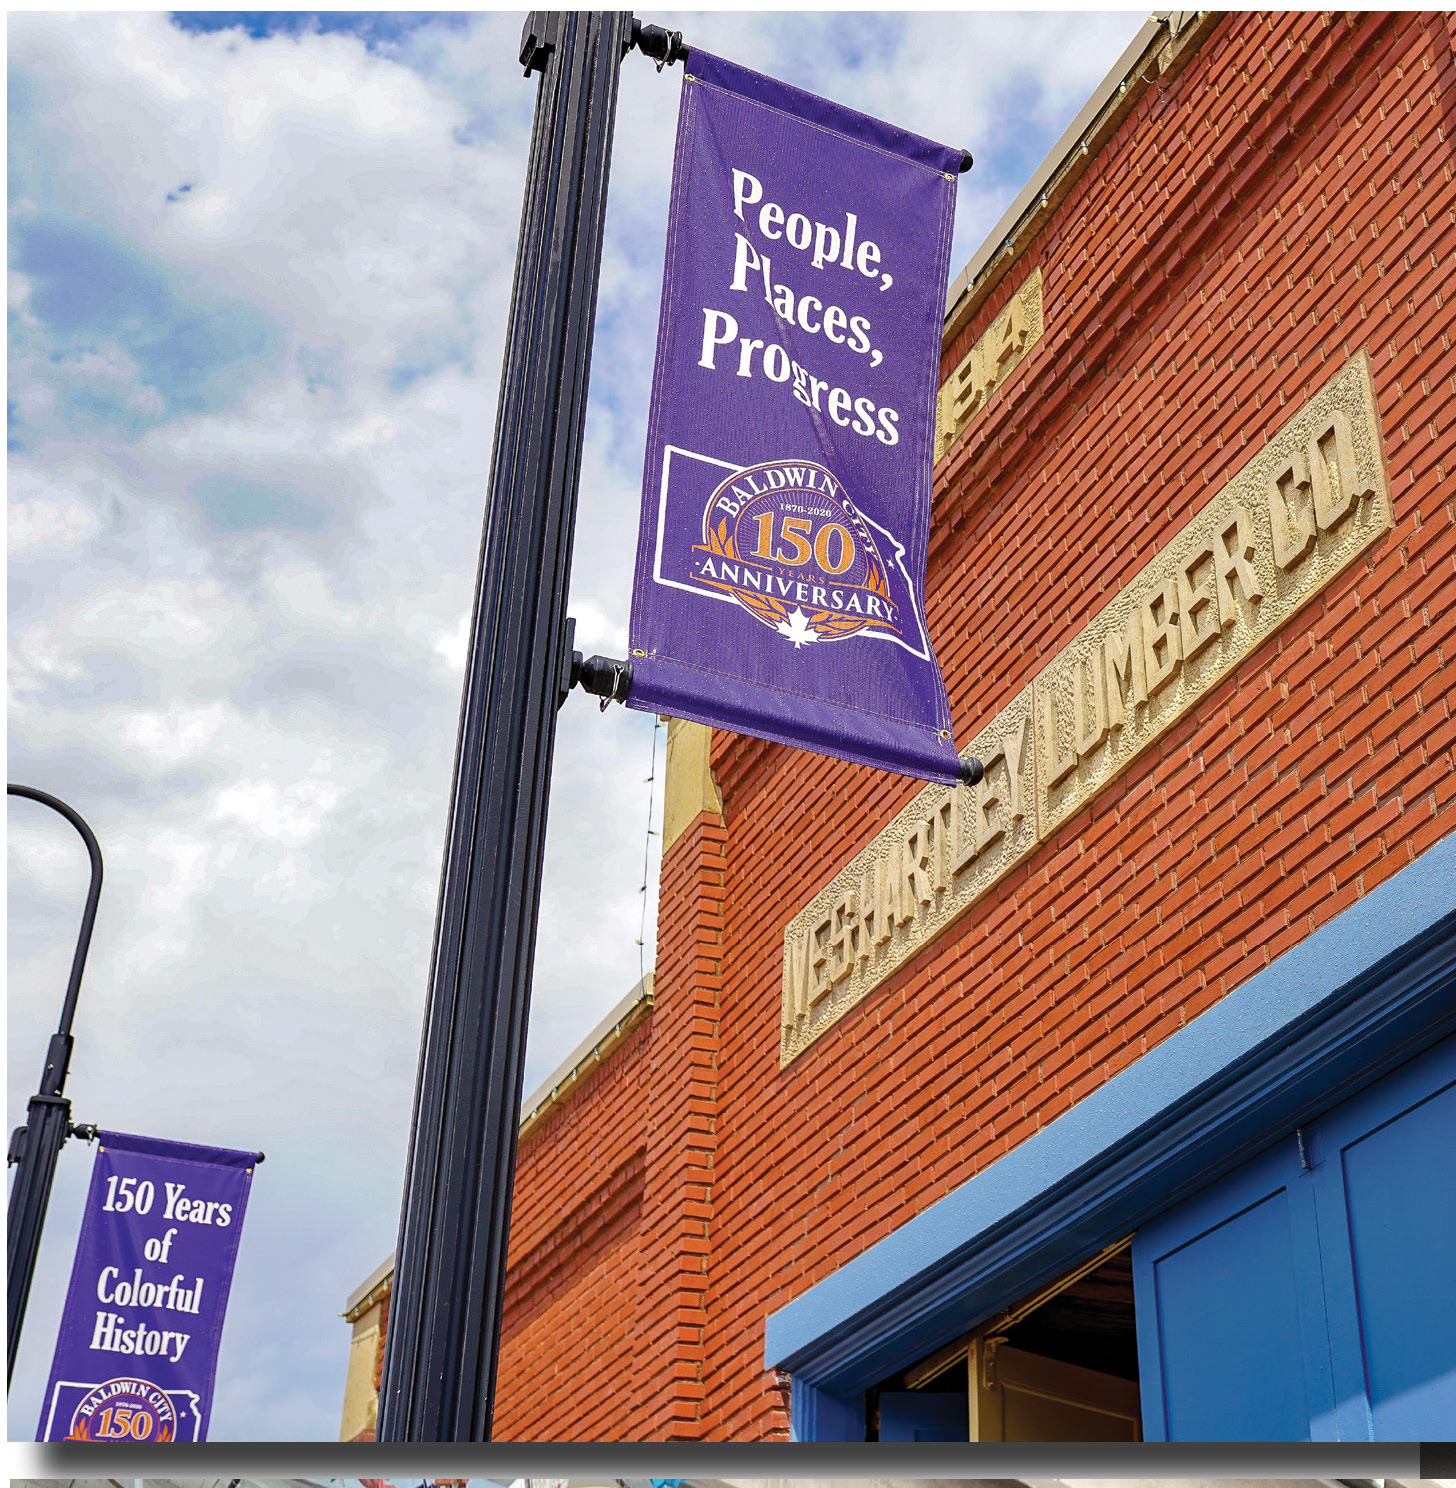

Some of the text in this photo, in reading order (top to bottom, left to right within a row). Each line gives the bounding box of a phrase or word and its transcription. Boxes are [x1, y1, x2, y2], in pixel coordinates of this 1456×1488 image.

[732, 168, 893, 292] People,
[730, 232, 883, 368] Places,
[698, 308, 899, 445] Progress
[942, 293, 1029, 438] 1914
[716, 467, 877, 560] BALDWIN CITY
[779, 502, 832, 518] 1870-2020
[750, 511, 855, 574] 150
[778, 566, 825, 584] YEARS
[1044, 506, 1263, 790] LUMBER
[1267, 409, 1376, 571] CO.
[102, 1175, 233, 1227] 150 Years
[144, 1228, 178, 1263] of
[97, 1266, 204, 1314] Colorful
[89, 1311, 190, 1363] History
[80, 1381, 173, 1422] BALDWIN CITY
[95, 1407, 153, 1440] 150
